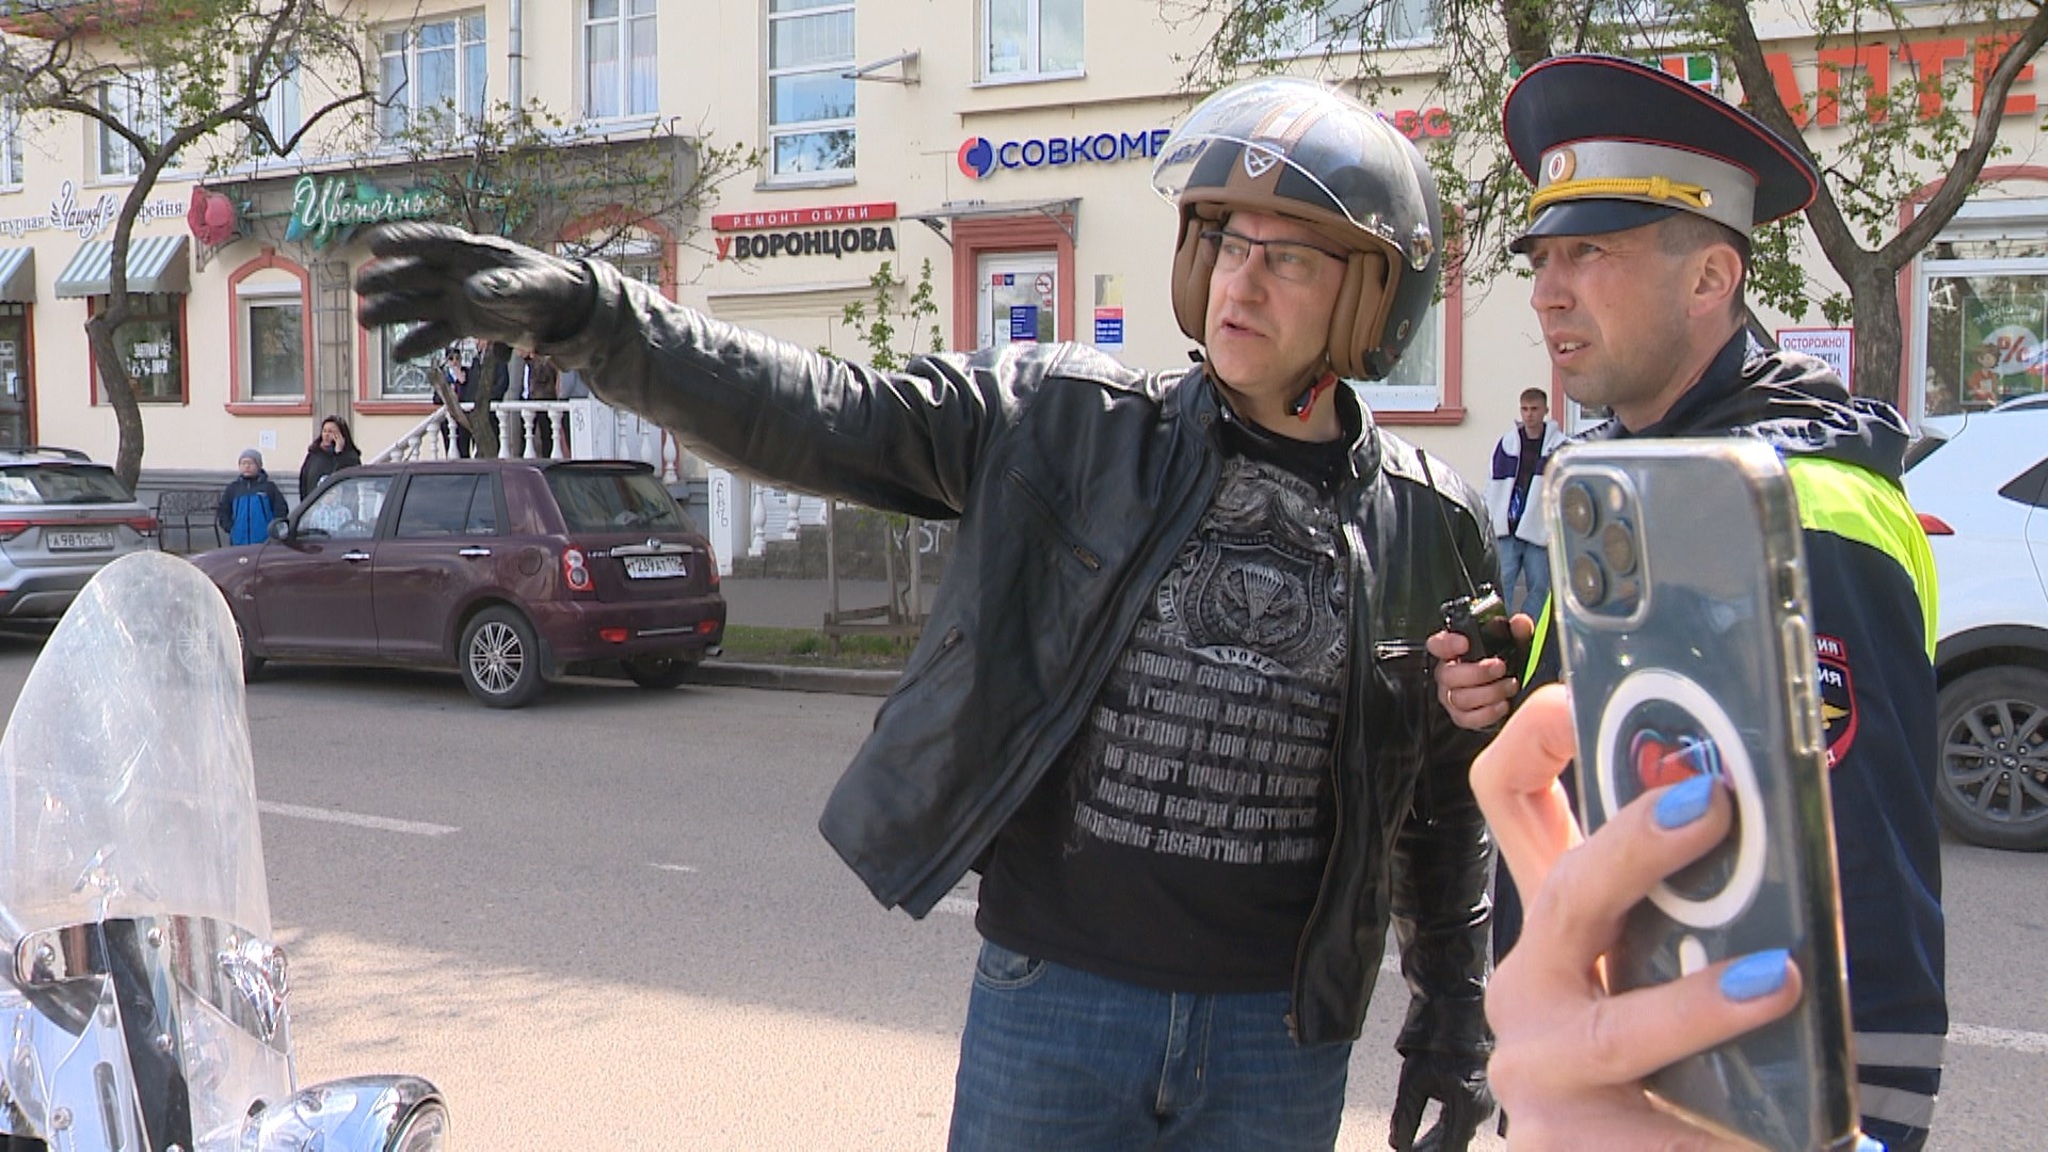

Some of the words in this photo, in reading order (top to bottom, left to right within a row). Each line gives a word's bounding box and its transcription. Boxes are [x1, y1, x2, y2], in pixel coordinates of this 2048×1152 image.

[0, 216, 45, 237] турная
[733, 212, 801, 227] РЕМОНТ
[811, 206, 869, 221] ОБУВИ
[735, 227, 896, 259] ВОРОНЦОВА
[1784, 337, 1845, 350] ОСТОРОЖНО!
[1214, 648, 1276, 672] КРОМЕ
